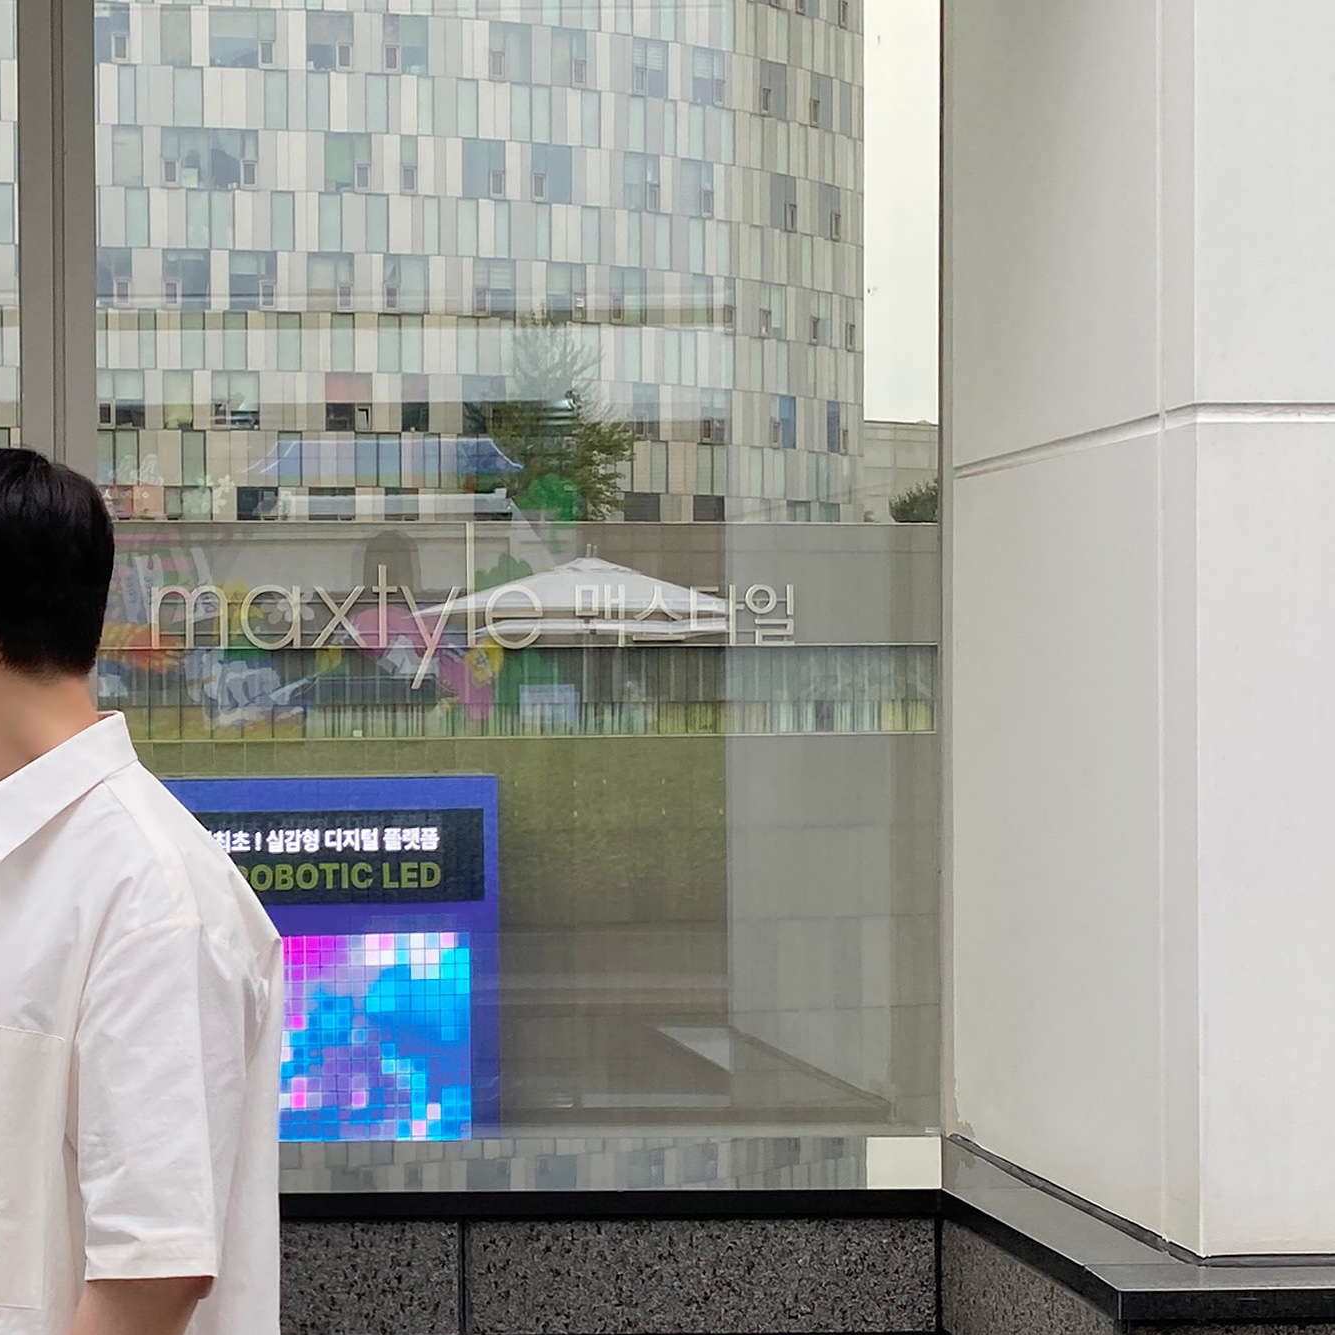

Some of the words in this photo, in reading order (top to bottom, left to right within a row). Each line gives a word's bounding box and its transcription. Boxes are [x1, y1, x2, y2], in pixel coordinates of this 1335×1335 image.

[150, 522, 544, 690] maxtyle
[574, 582, 796, 647] 맥스타일
[207, 829, 262, 854] 최초!
[266, 828, 320, 854] 실감형
[324, 827, 379, 852] 디지털
[383, 826, 440, 852] 플랫폼
[382, 861, 441, 889] LED
